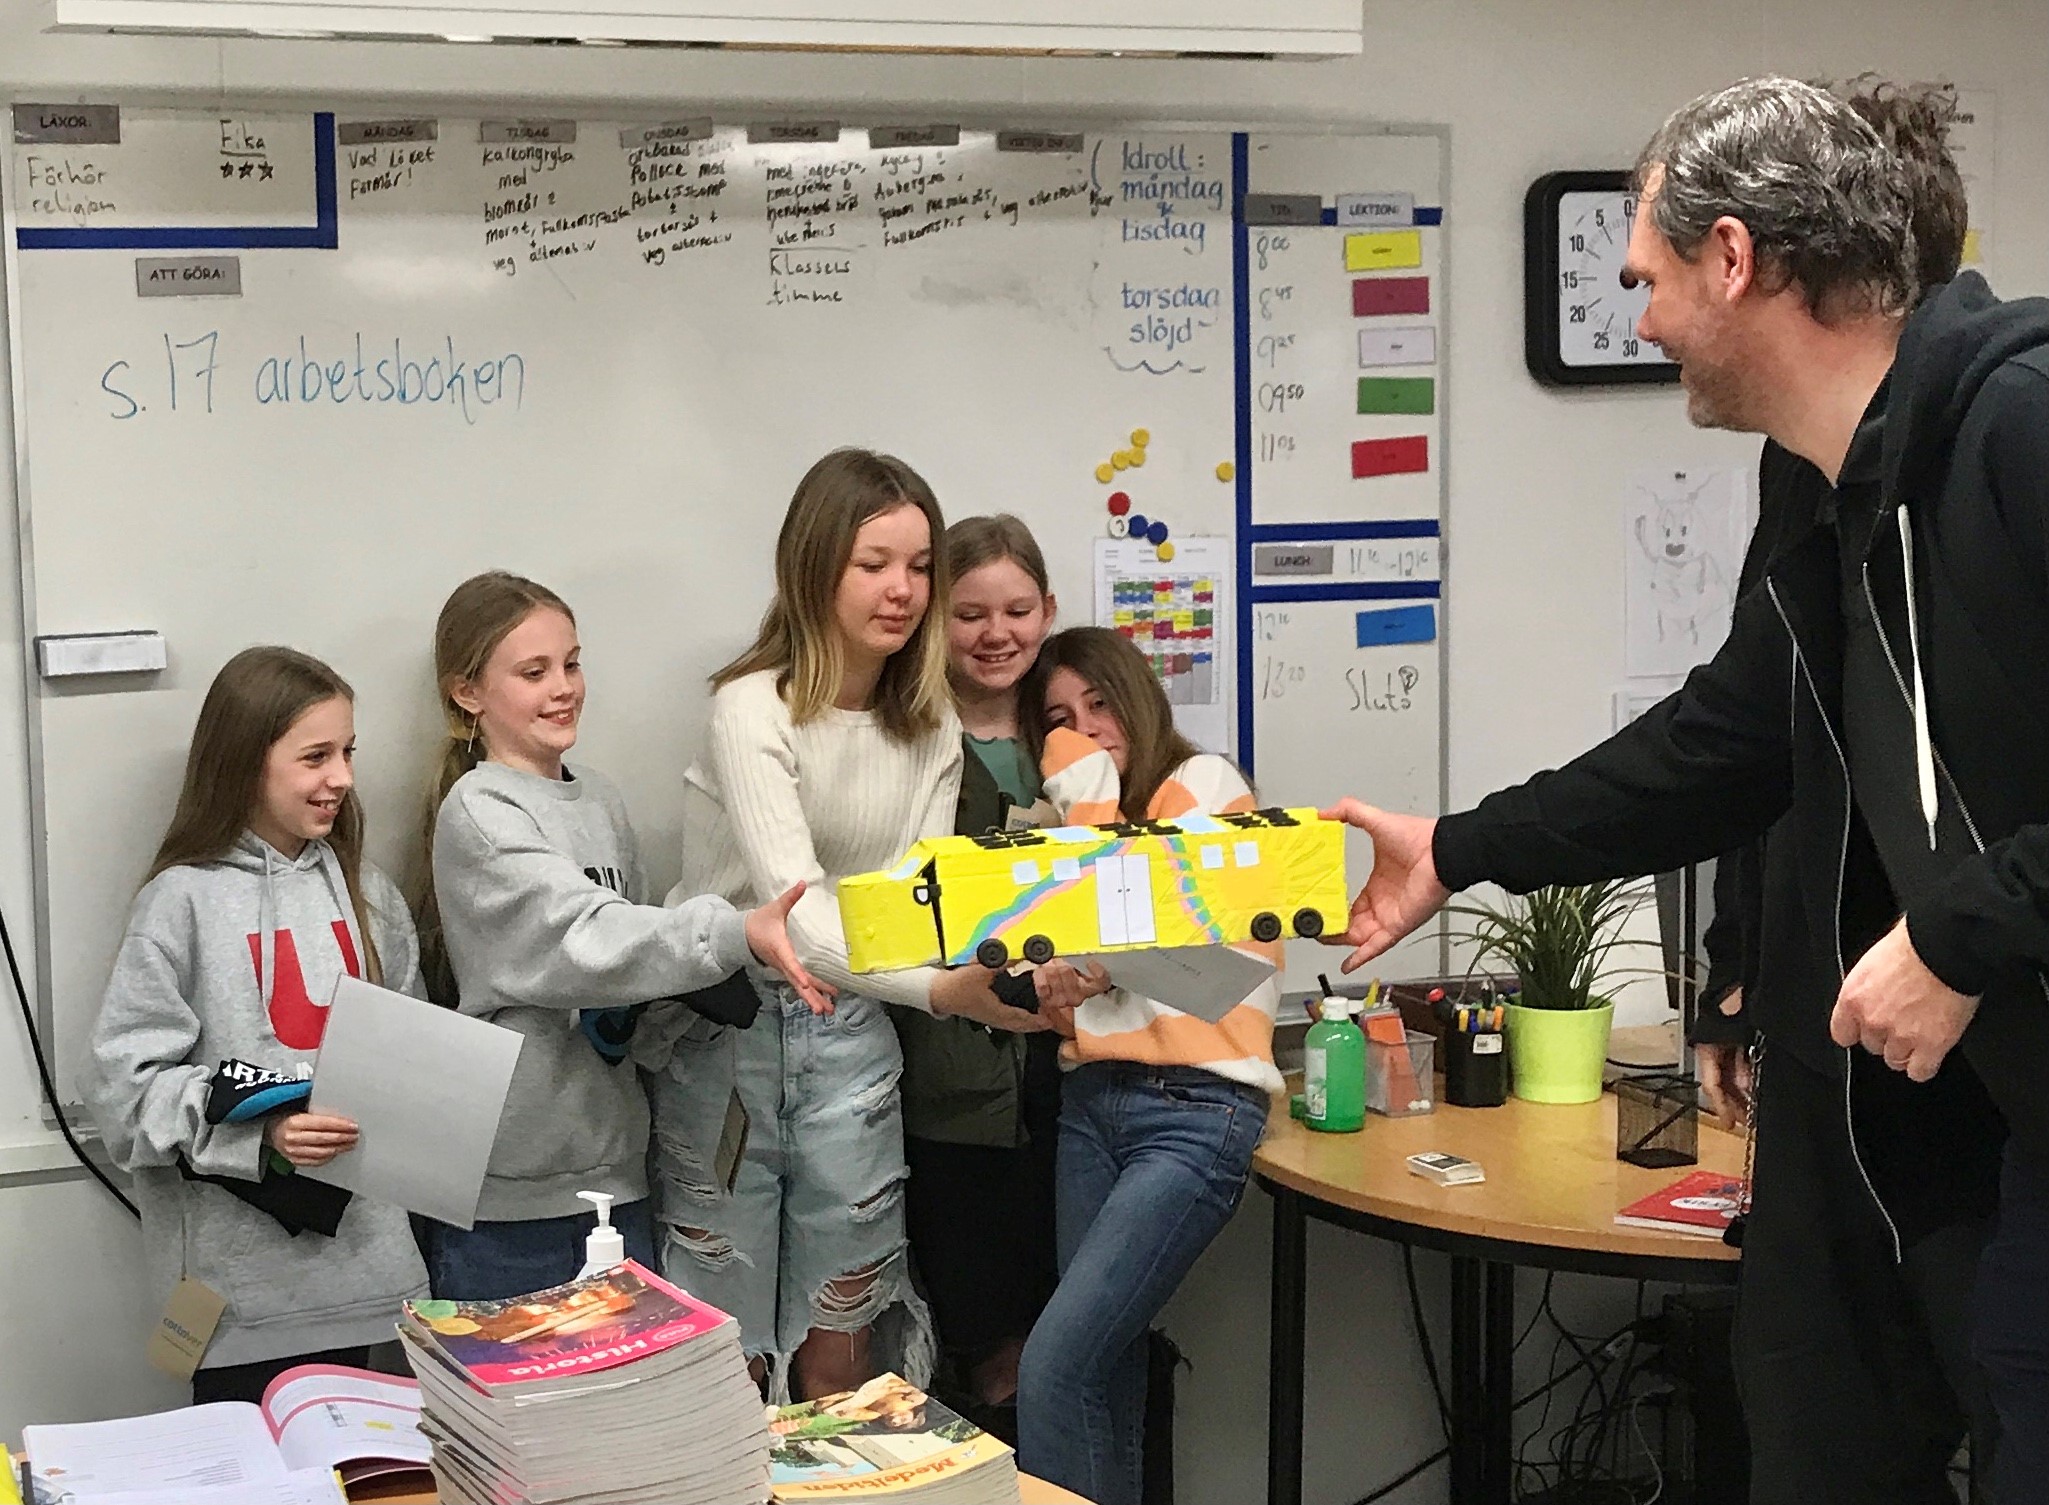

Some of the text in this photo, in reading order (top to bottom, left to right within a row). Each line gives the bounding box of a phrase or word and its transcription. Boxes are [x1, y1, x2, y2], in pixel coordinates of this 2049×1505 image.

[219, 119, 266, 149] Fika
[27, 156, 107, 189] Förhör
[1120, 173, 1223, 211] måndag
[1569, 234, 1584, 251] 10
[149, 268, 178, 281] ATT
[1561, 271, 1578, 288] 15
[1570, 305, 1586, 323] 20
[1129, 314, 1192, 351] slöjd
[1593, 332, 1609, 350] 25
[1622, 340, 1638, 357] 30
[256, 332, 524, 425] arbetsboken
[507, 1338, 649, 1378] Historia
[802, 1457, 960, 1492] Medeltiden
